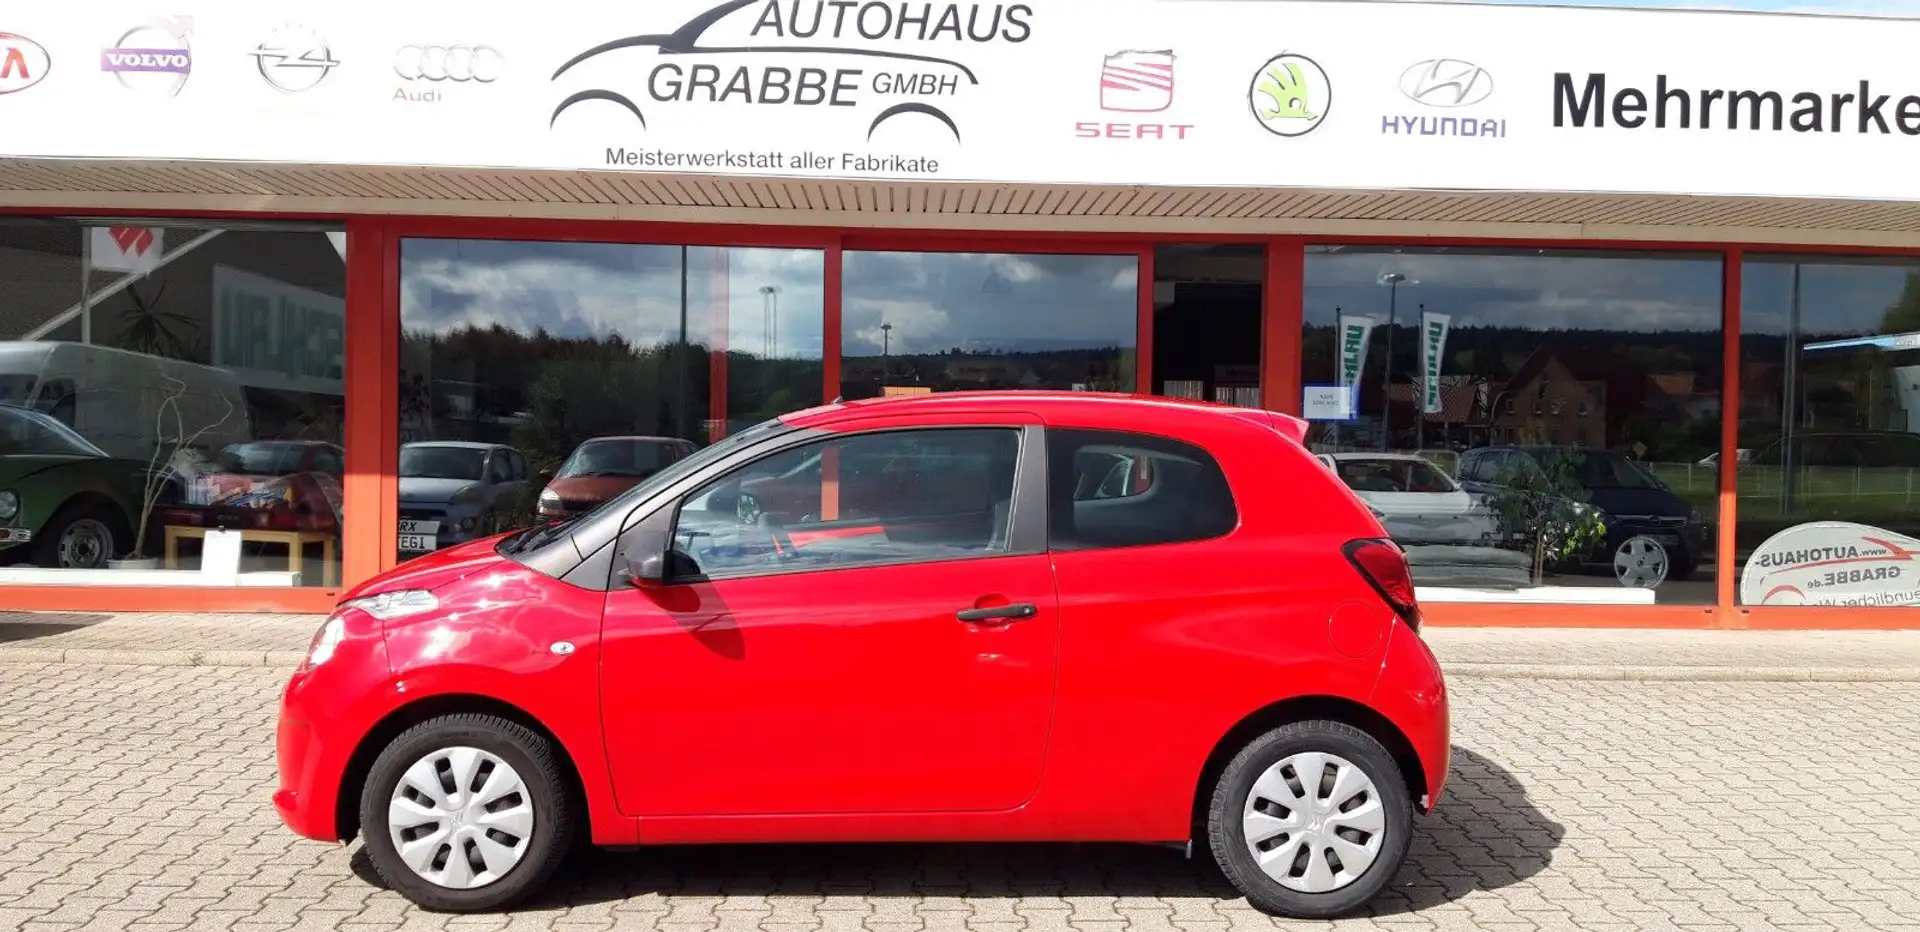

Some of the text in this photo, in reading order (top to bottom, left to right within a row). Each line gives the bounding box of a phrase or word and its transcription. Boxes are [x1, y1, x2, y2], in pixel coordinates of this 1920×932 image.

[750, 0, 1033, 43] AUTOHAUS
[106, 53, 188, 68] VOLVO
[393, 88, 442, 102] Audi
[648, 63, 958, 107] GRABBE GMBH
[1075, 121, 1195, 140] SEAT
[1382, 115, 1506, 138] HYUNDAI
[606, 147, 939, 174] Meisterwerkstatt aller Fabrikate
